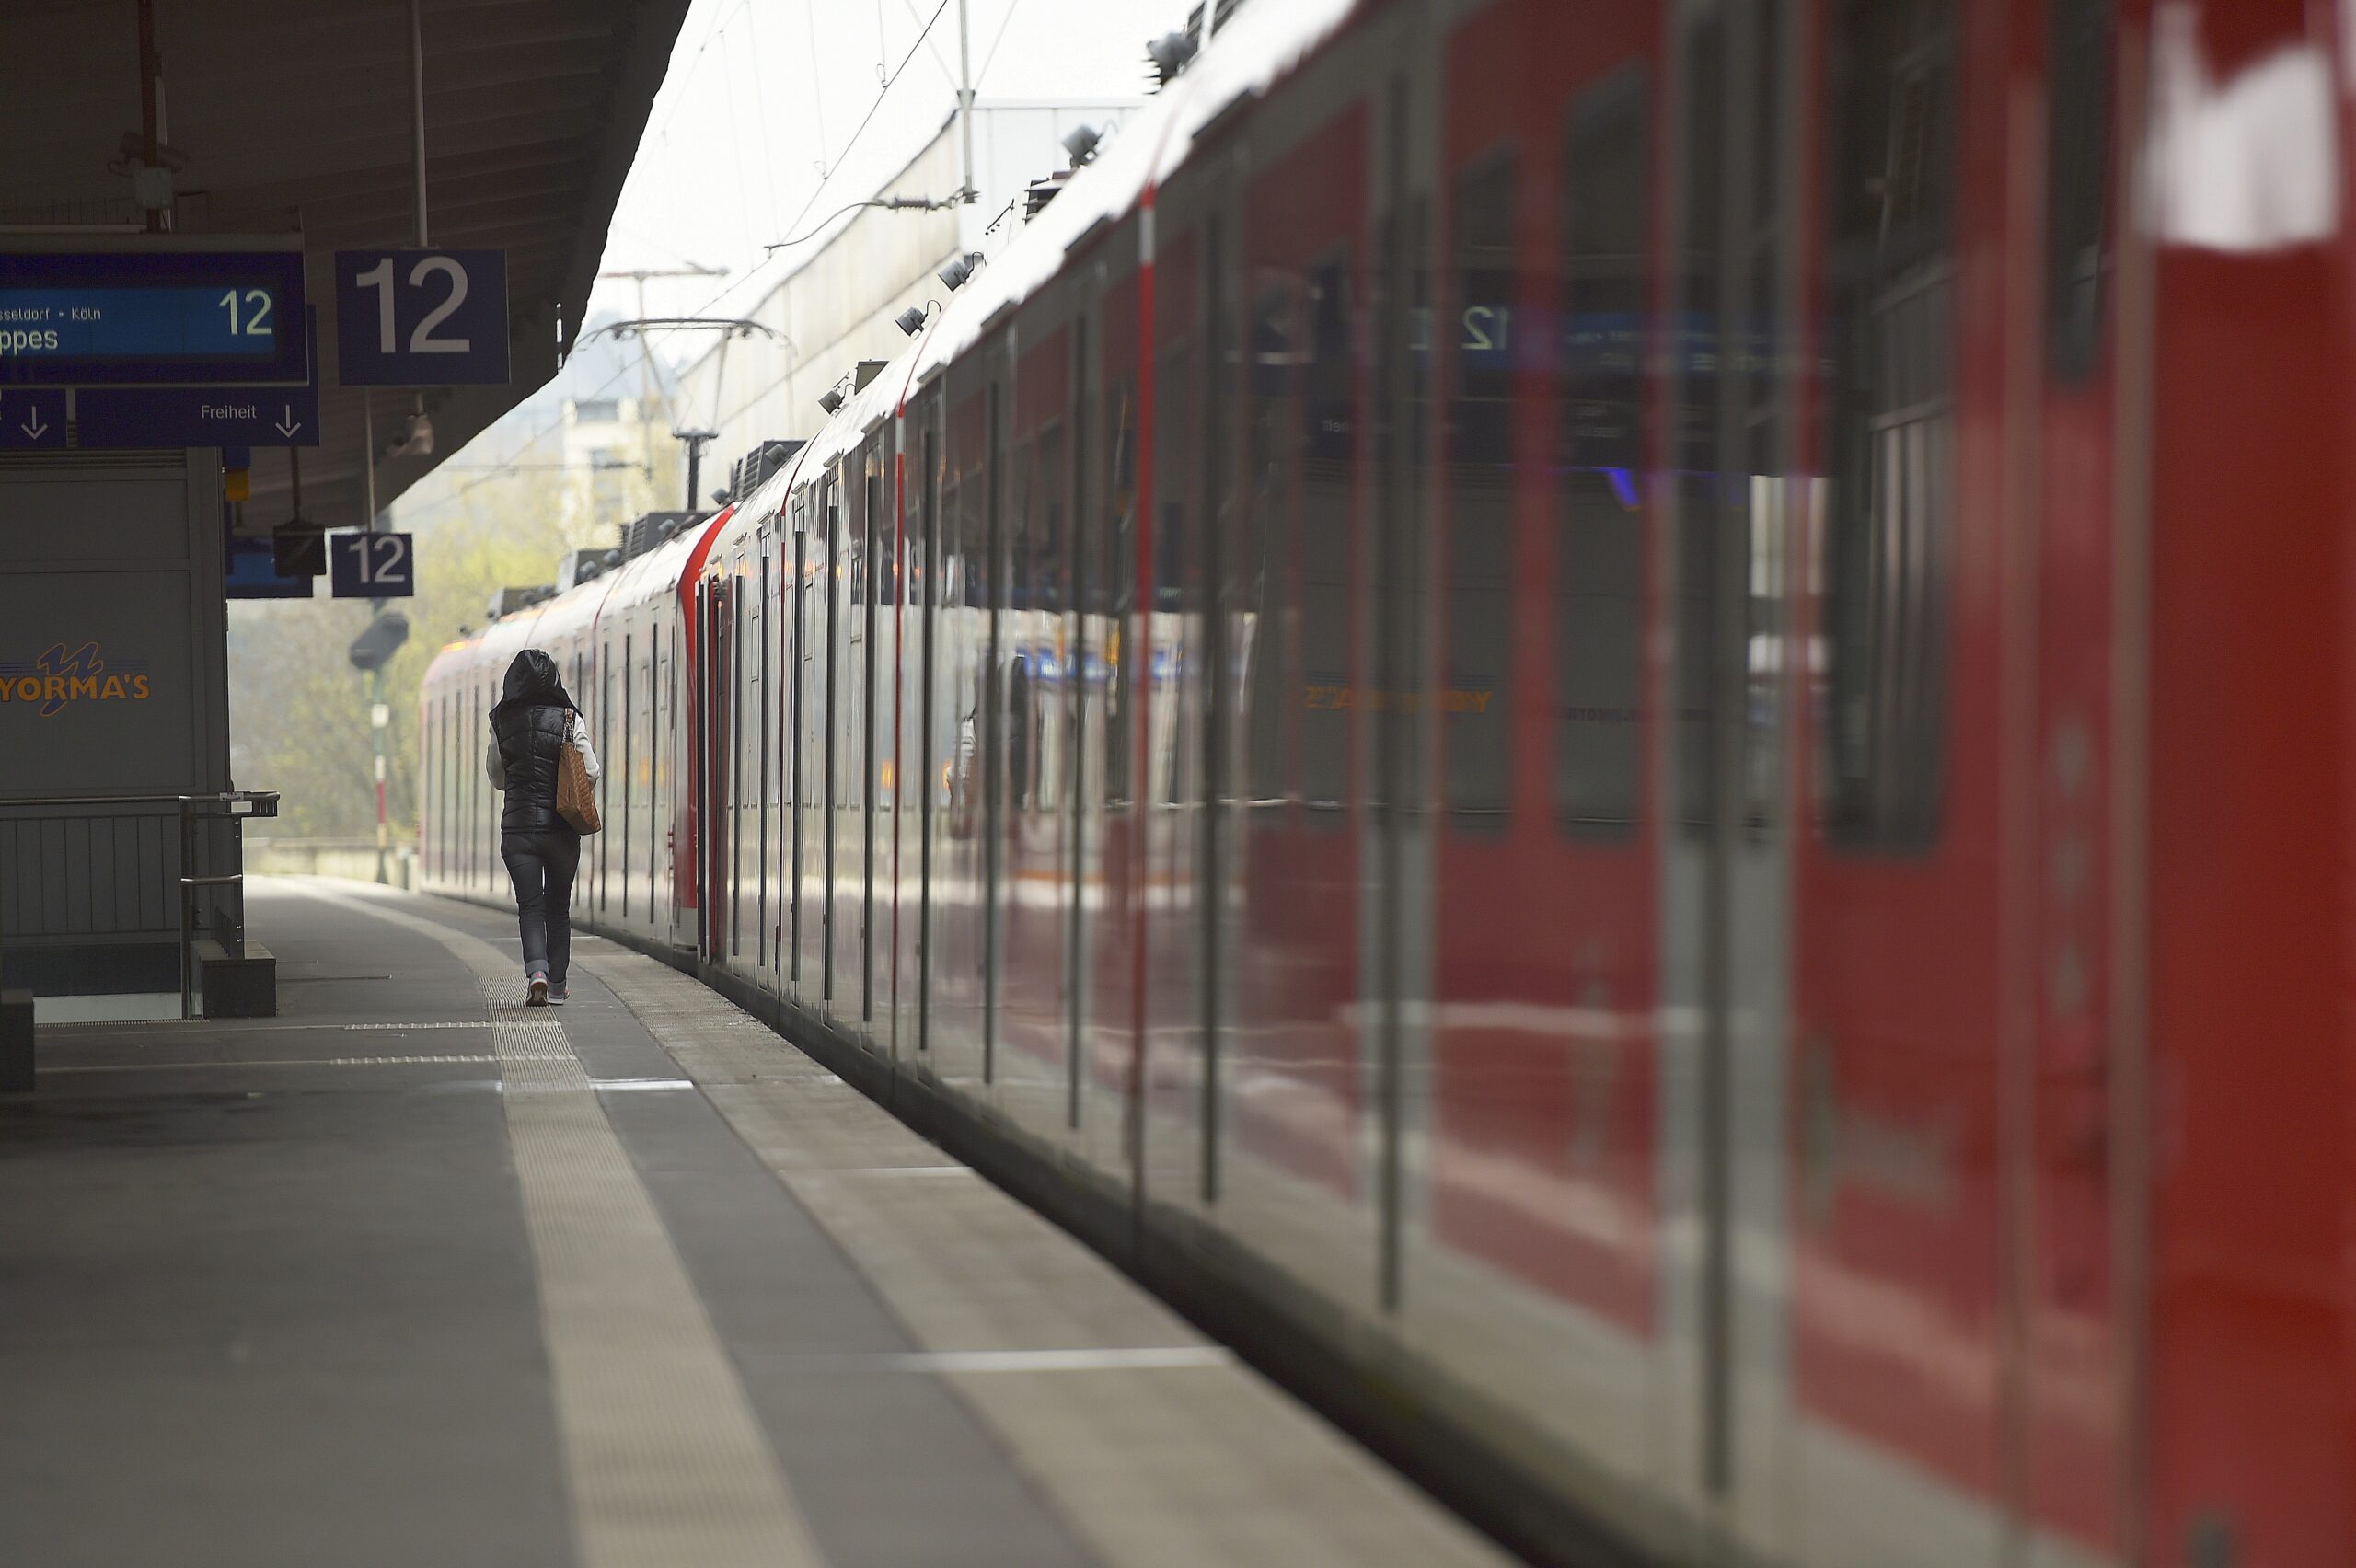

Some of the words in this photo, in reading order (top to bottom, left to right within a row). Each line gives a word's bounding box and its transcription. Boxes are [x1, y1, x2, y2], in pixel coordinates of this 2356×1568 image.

[71, 306, 101, 321] Köln
[219, 289, 272, 335] 12
[355, 256, 470, 353] 12
[0, 329, 59, 356] ppes
[201, 404, 257, 419] Freiheit
[348, 535, 406, 584] 12
[0, 674, 150, 701] YORMA'S
